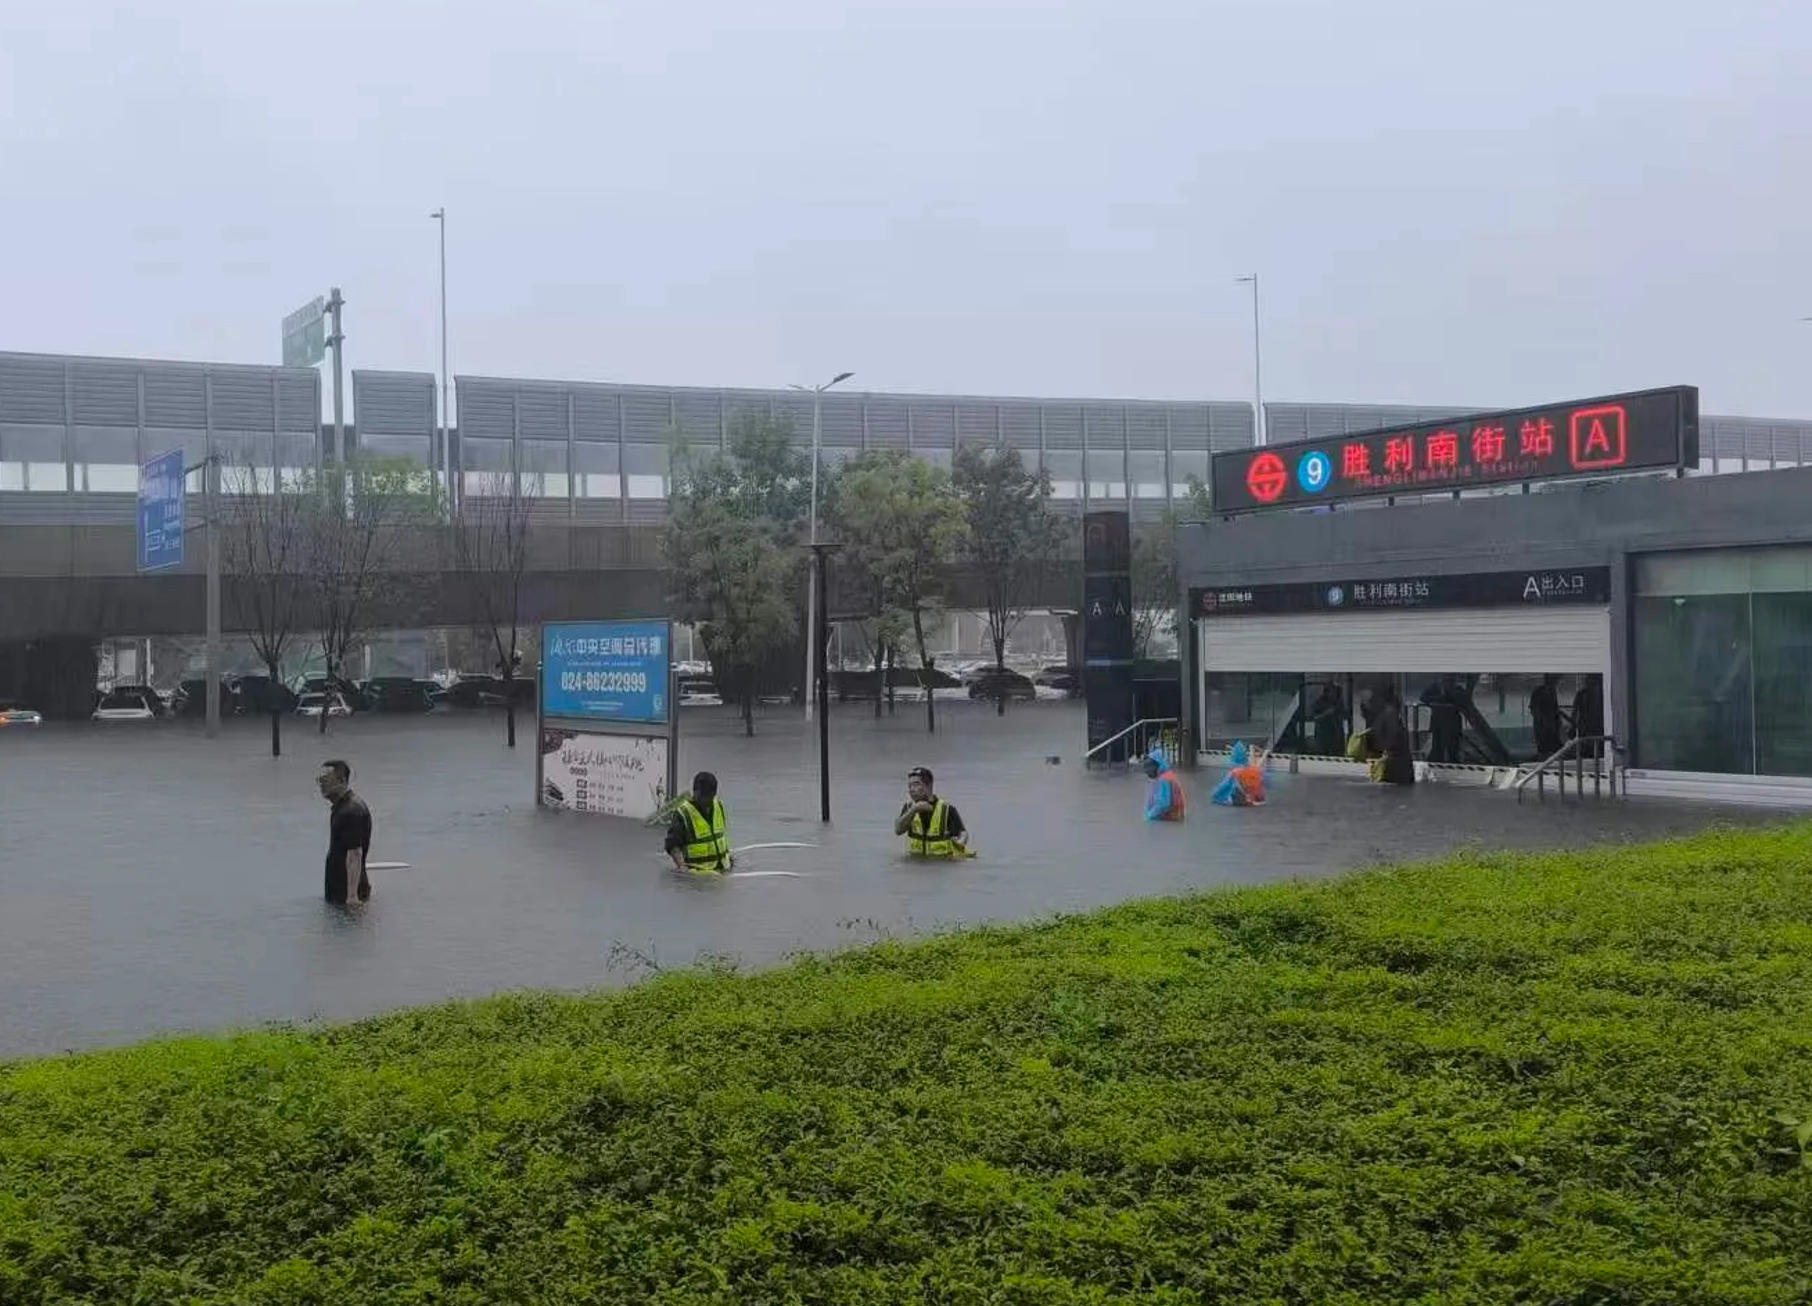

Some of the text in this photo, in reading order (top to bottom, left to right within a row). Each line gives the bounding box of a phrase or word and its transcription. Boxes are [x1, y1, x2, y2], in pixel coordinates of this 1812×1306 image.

[1306, 418, 1609, 485] 9 胜利南街站 A
[1354, 582, 1429, 599] 胜利南街站
[1523, 574, 1585, 599] A 出入口
[1092, 602, 1102, 616] A
